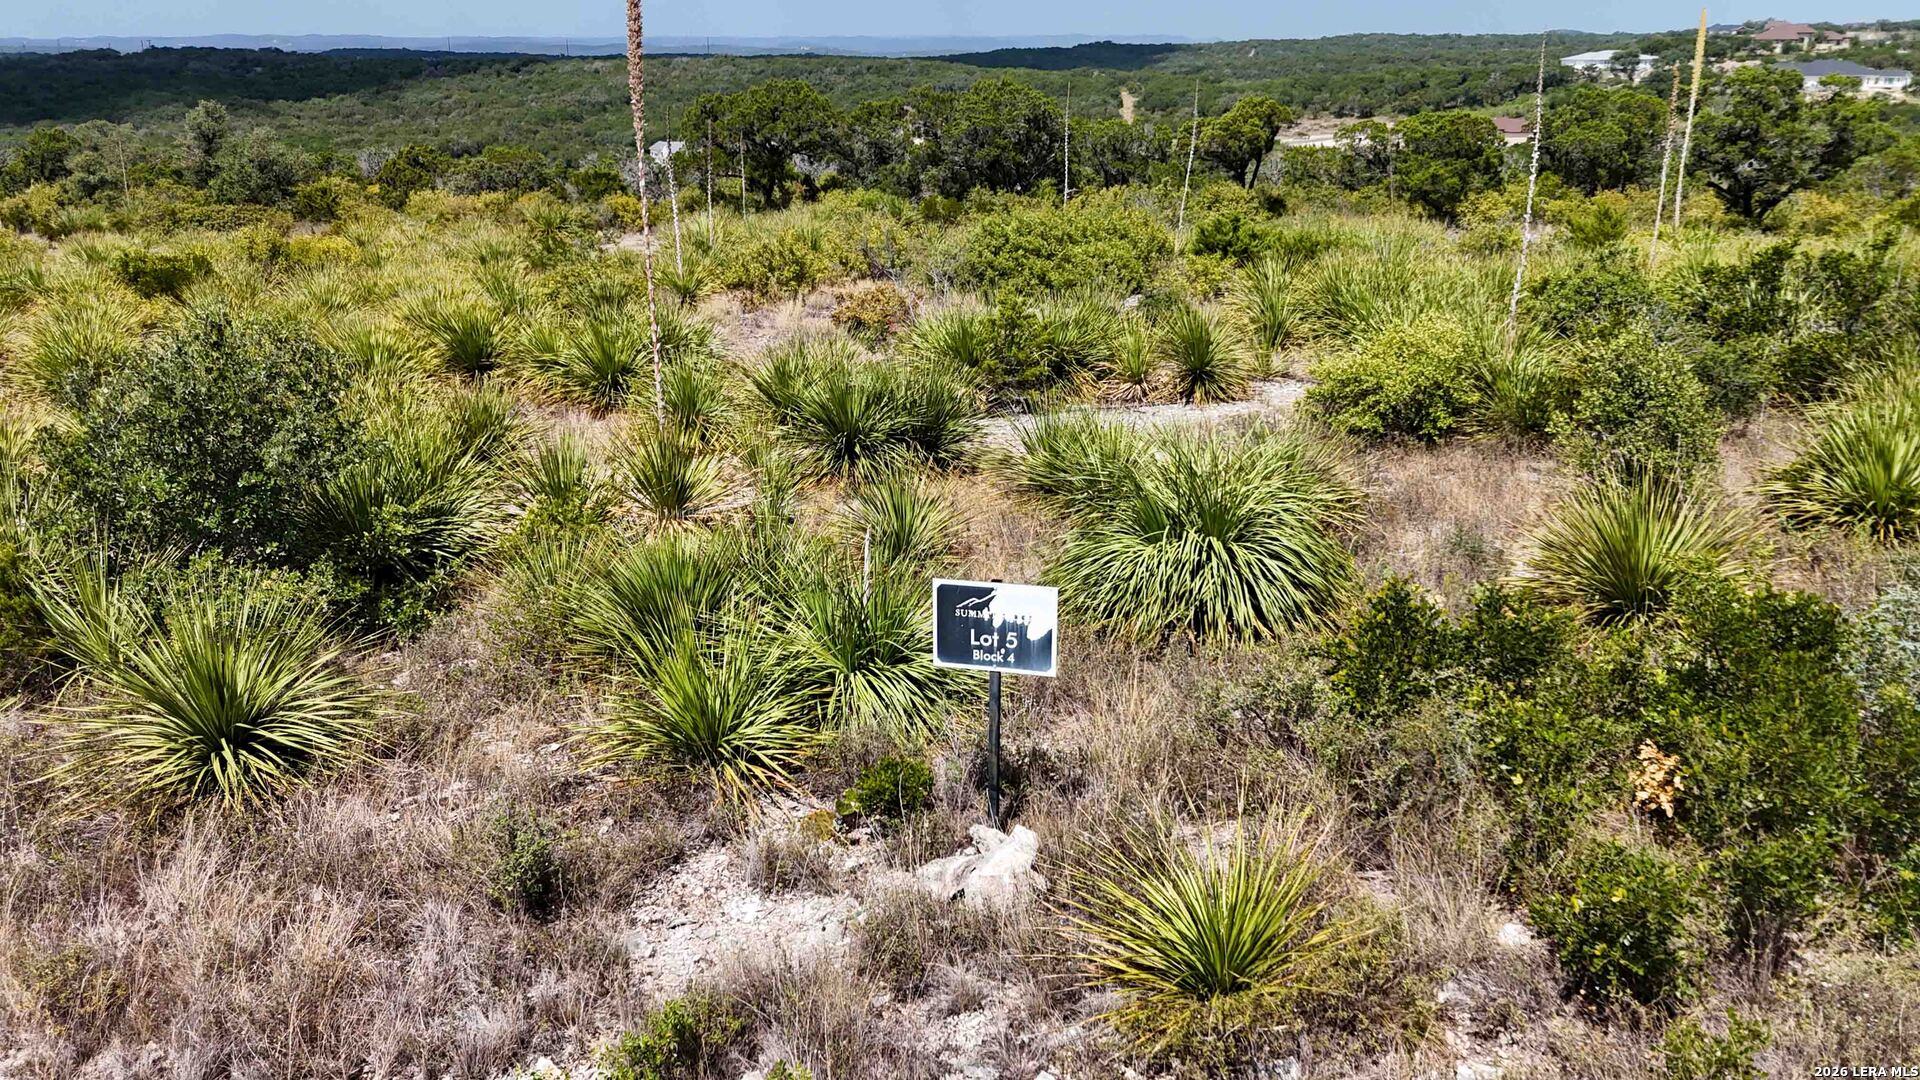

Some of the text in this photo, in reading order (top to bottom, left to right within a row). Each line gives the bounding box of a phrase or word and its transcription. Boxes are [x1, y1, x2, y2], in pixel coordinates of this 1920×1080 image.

[970, 629, 1018, 649] Lot 5
[973, 649, 1015, 663] Block 4
